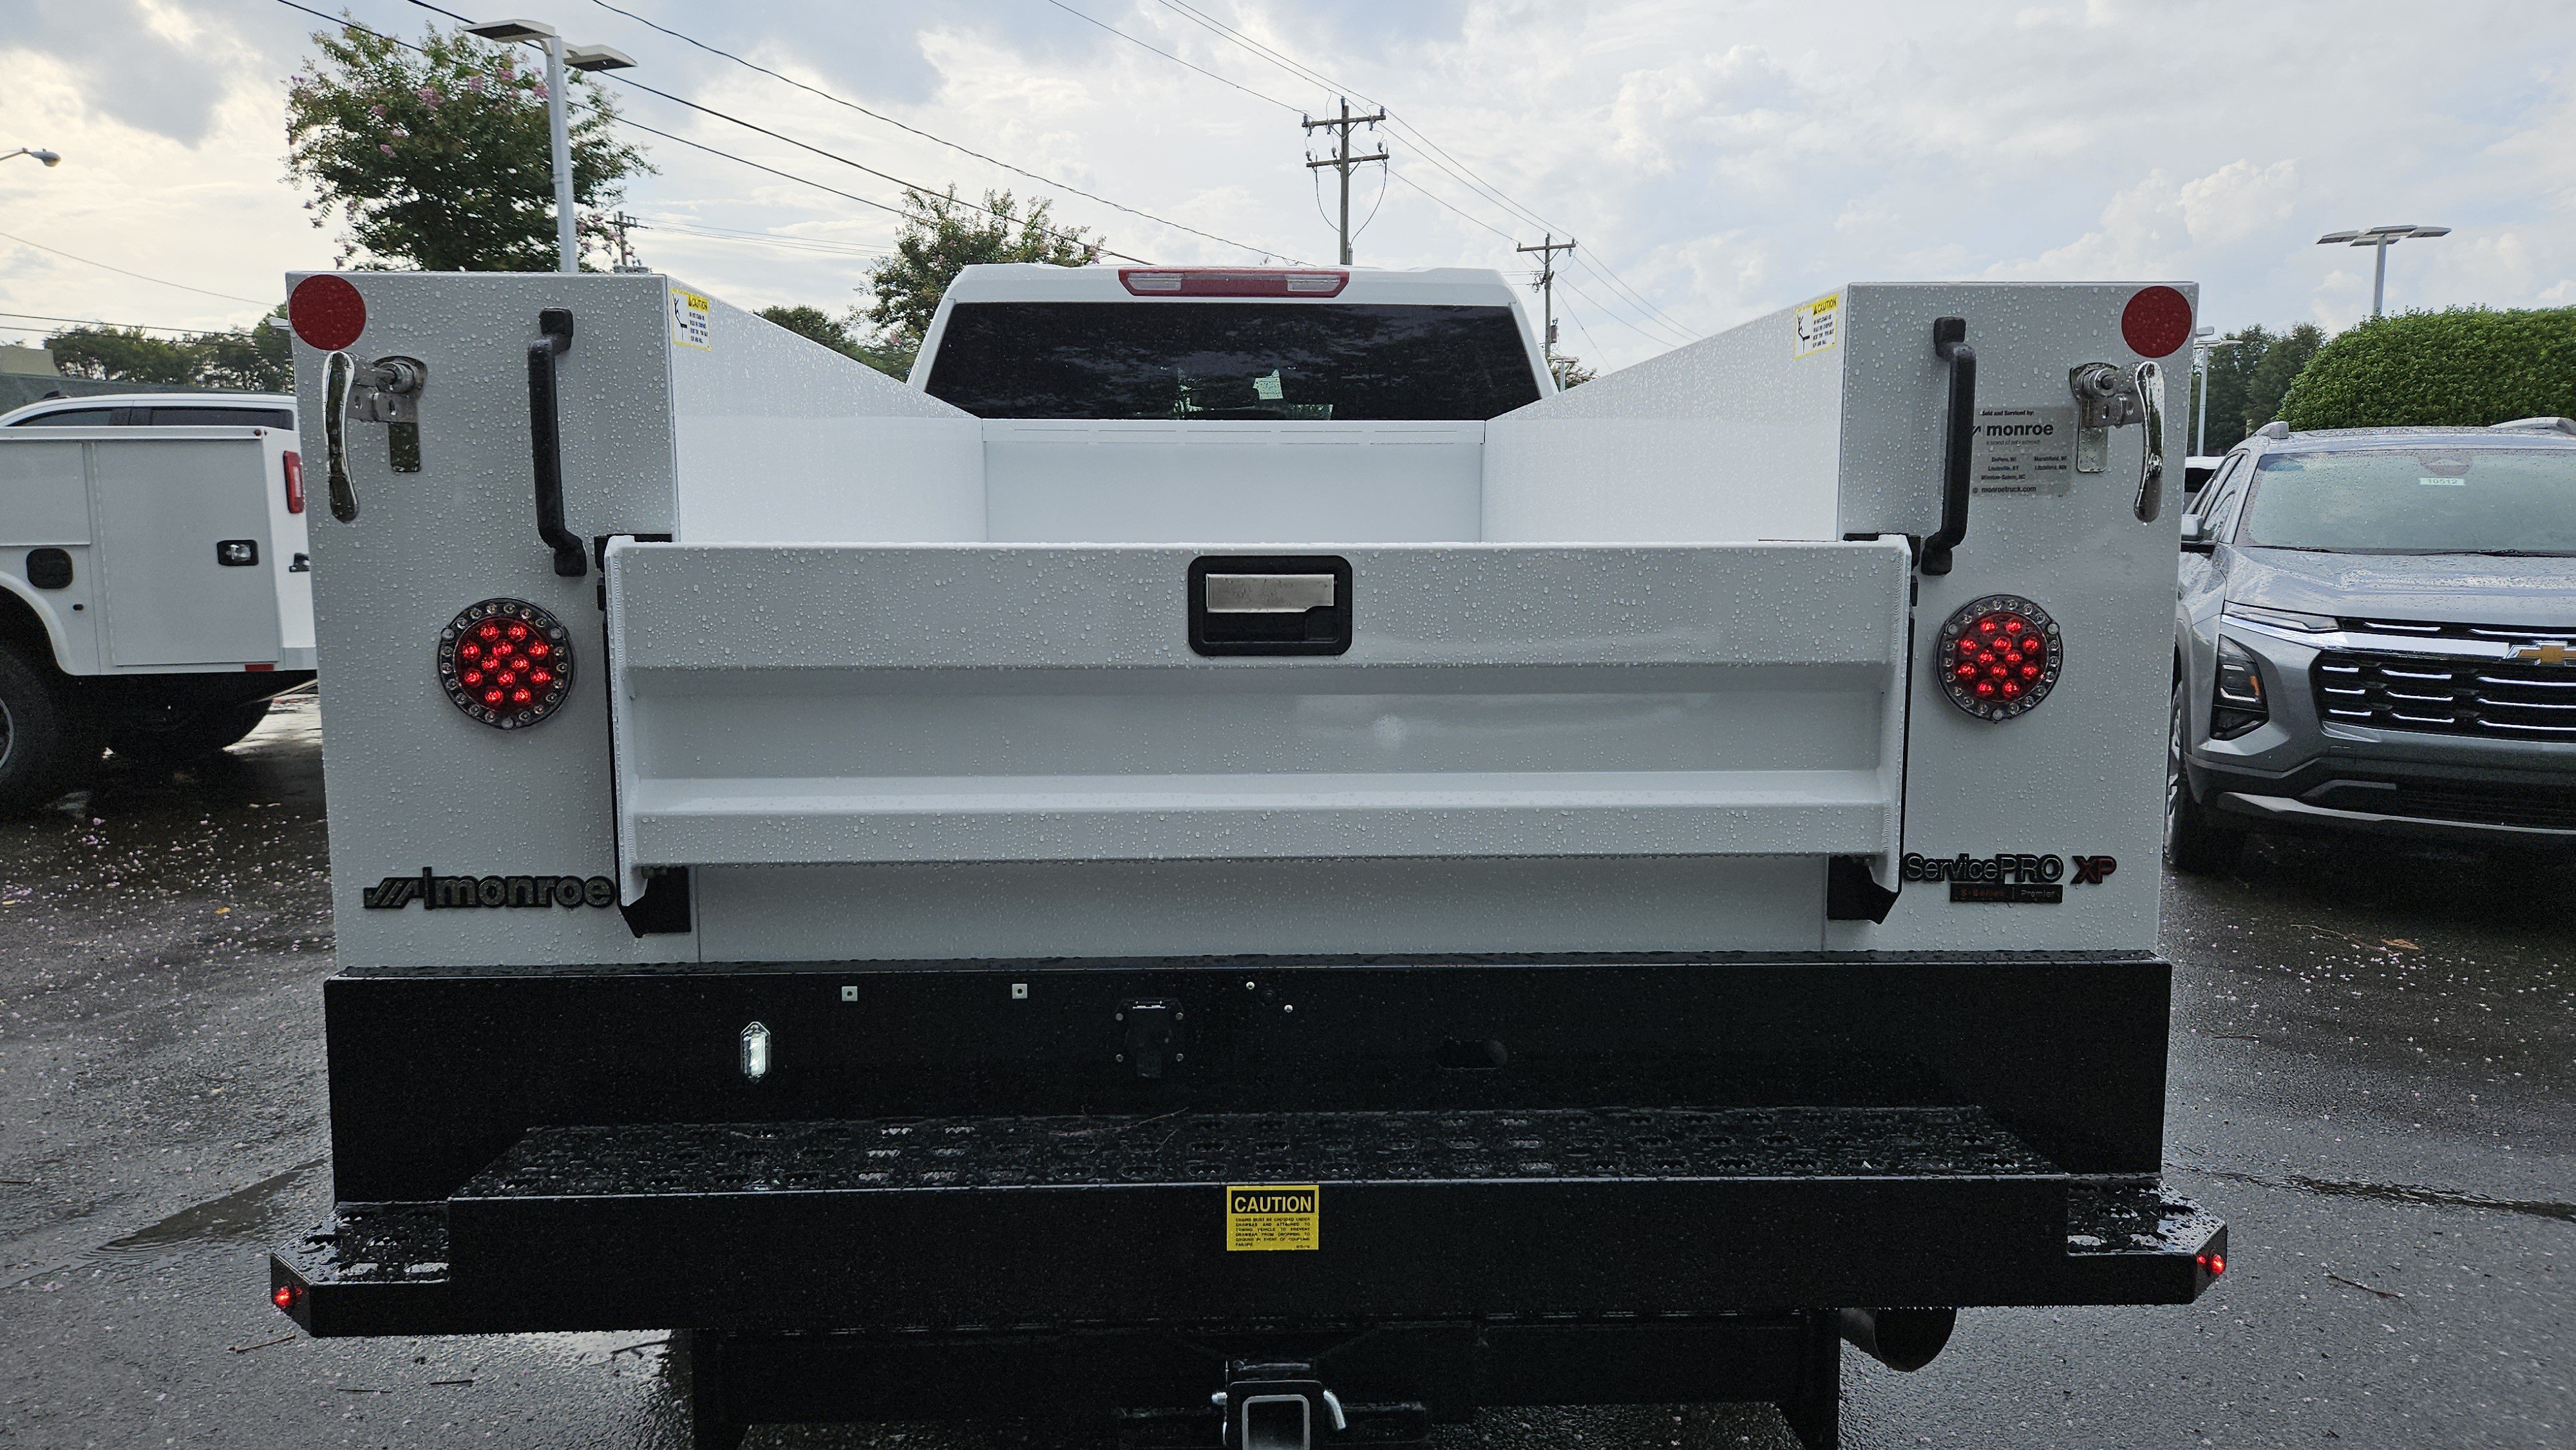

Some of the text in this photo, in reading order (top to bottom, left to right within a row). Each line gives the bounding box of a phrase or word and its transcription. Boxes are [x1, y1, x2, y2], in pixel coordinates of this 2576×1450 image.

[1817, 298, 1837, 313] CAUTION
[1987, 424, 2054, 436] monroe
[2070, 855, 2117, 884] XP
[431, 874, 616, 909] monroe
[1235, 1196, 1311, 1212] CAUTION
